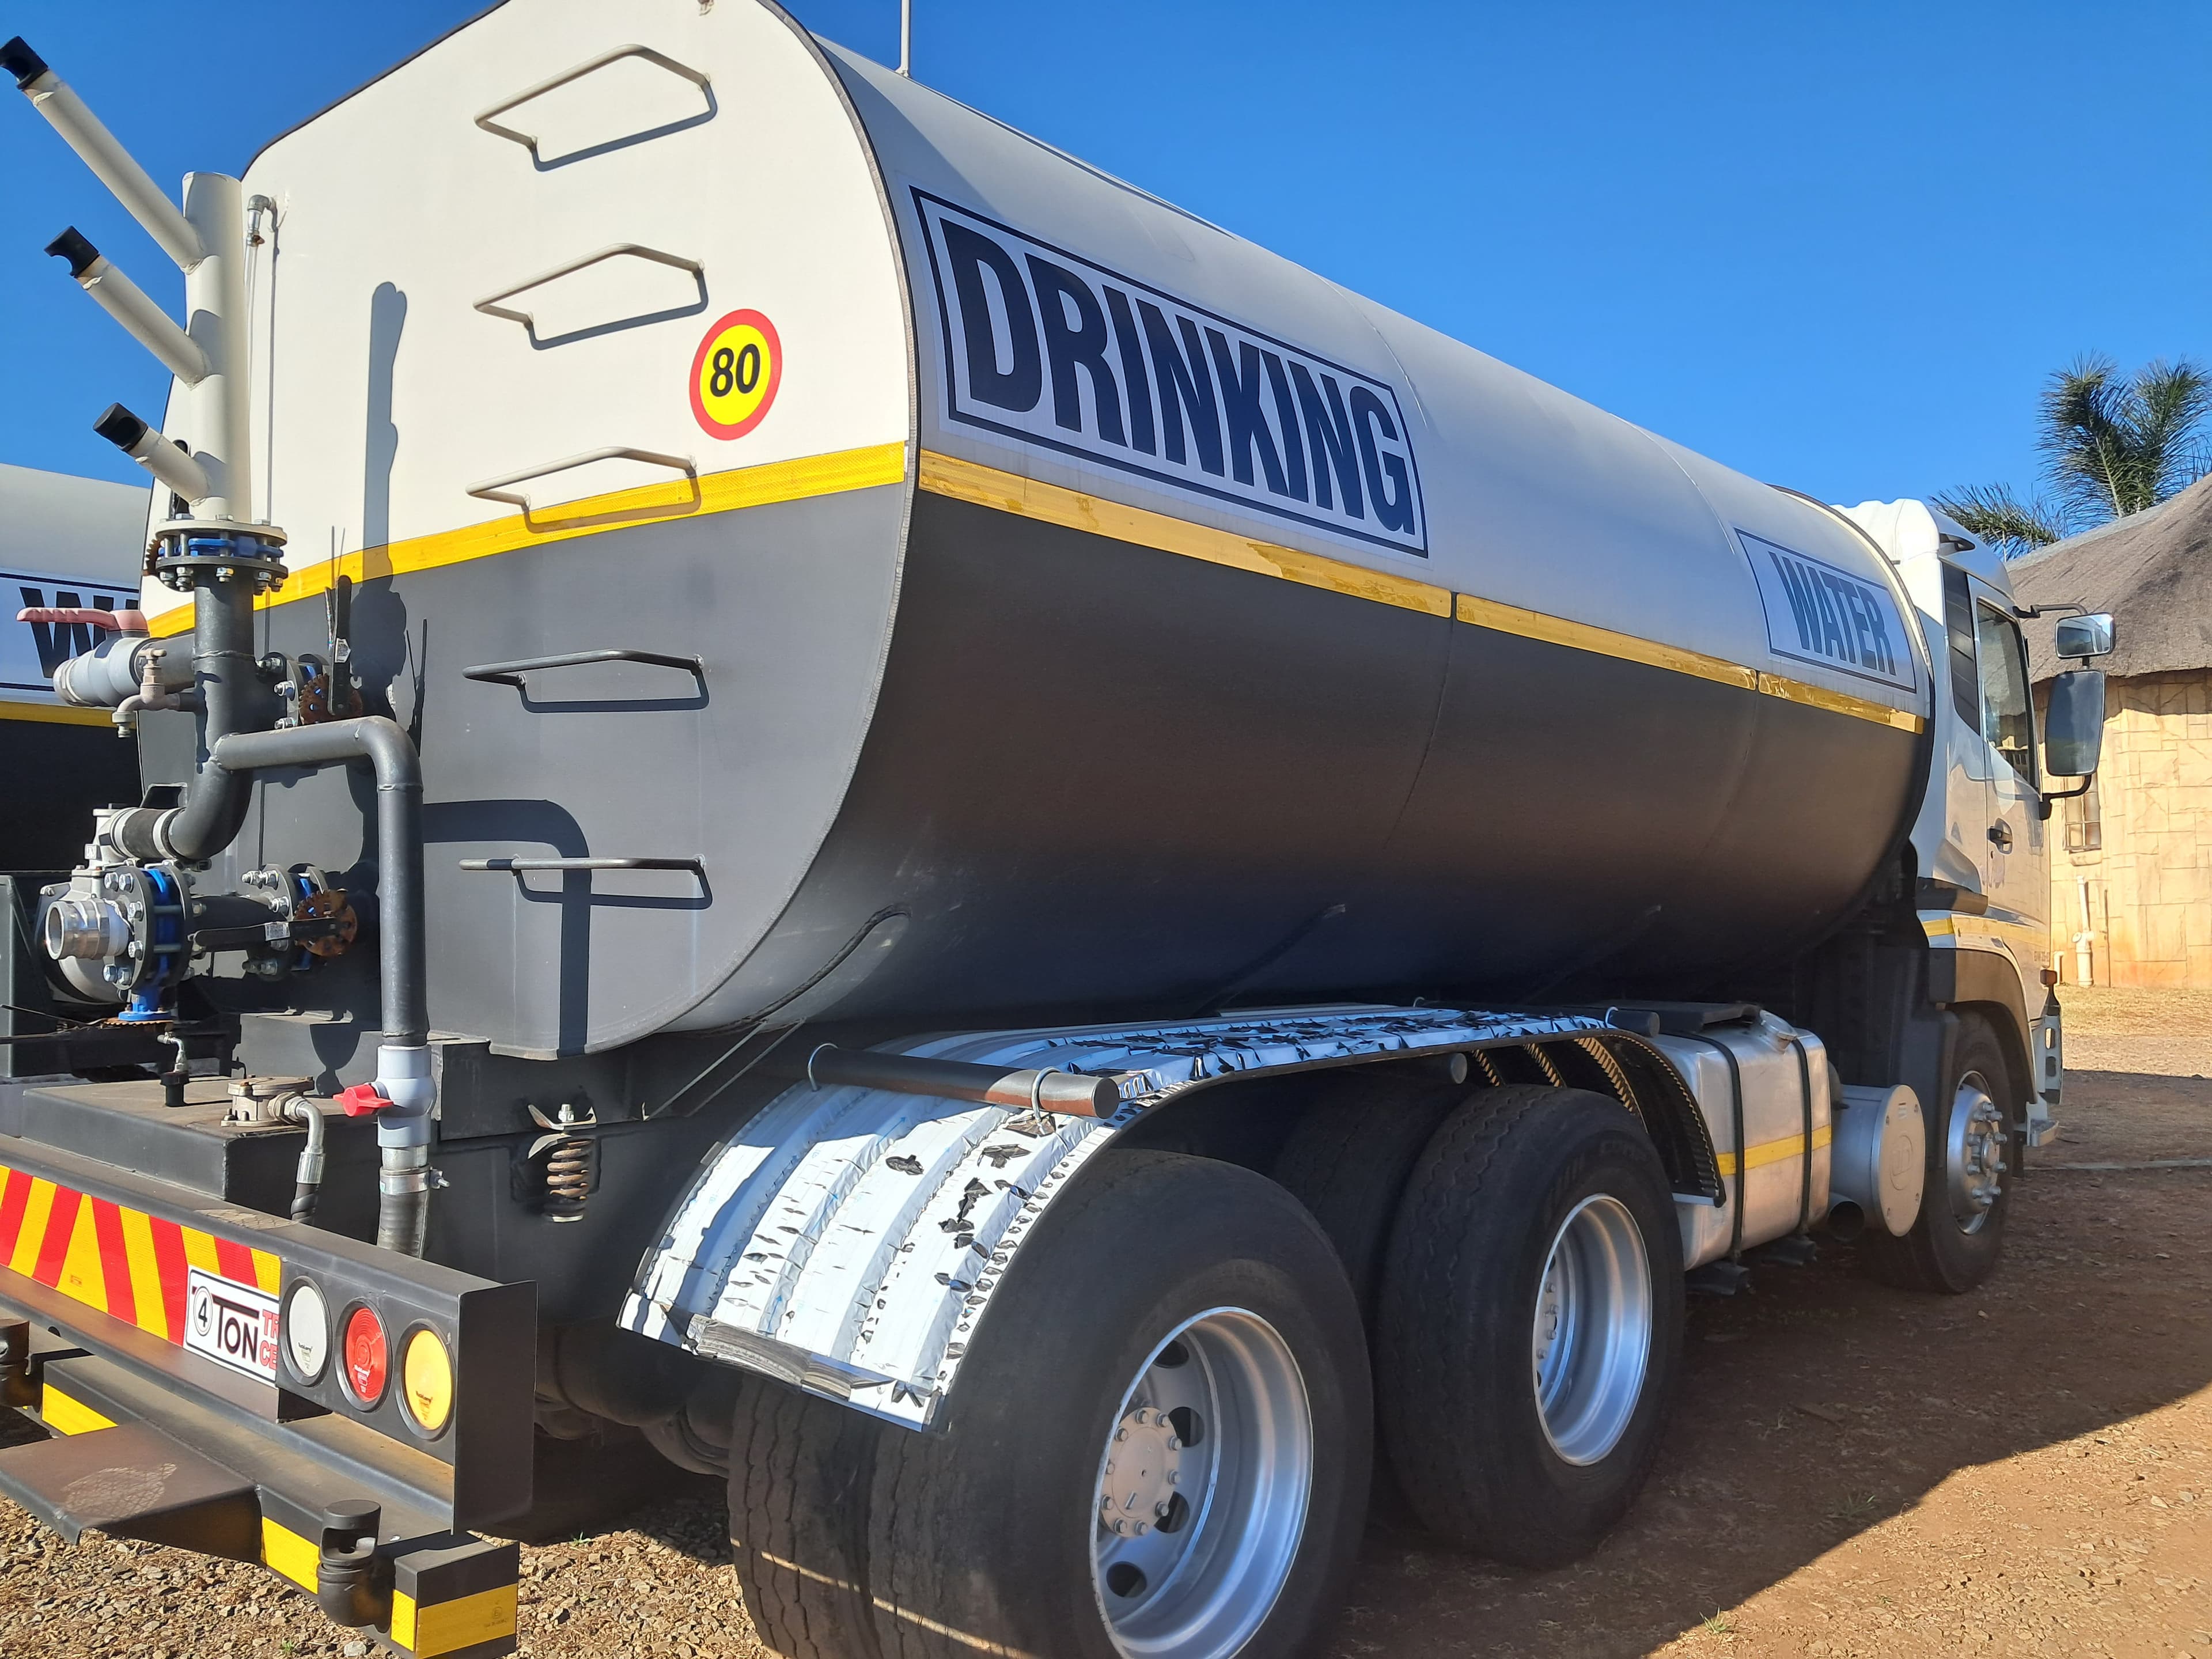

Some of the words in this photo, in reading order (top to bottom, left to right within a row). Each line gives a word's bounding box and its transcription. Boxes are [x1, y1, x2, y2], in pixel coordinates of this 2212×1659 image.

[710, 343, 761, 397] 80
[939, 217, 1415, 535] DRINKING
[1767, 551, 1897, 676] WATER
[198, 1297, 208, 1328] 4
[211, 1293, 260, 1363] TON
